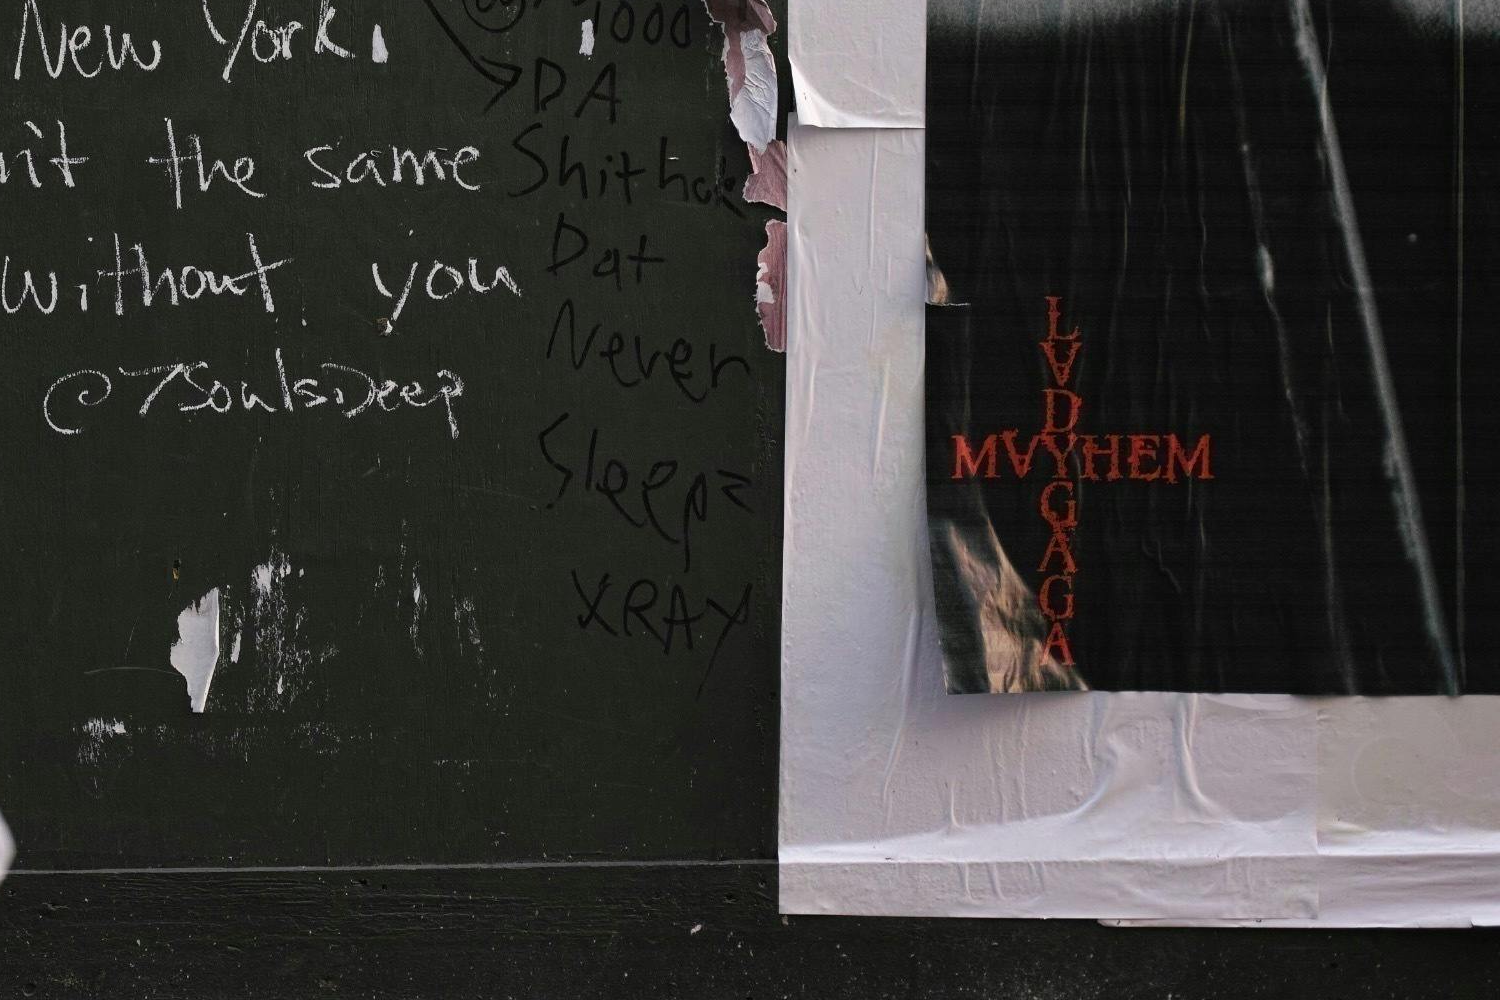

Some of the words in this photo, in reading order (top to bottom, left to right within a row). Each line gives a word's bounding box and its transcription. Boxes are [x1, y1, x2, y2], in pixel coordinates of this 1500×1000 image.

[593, 0, 693, 49] 1000
[147, 117, 267, 210] the
[303, 143, 482, 192] same
[0, 232, 295, 316] without
[371, 257, 522, 324] you
[546, 299, 753, 403] Never
[1037, 480, 1080, 668] GAGA
[571, 568, 755, 702] XRAY
